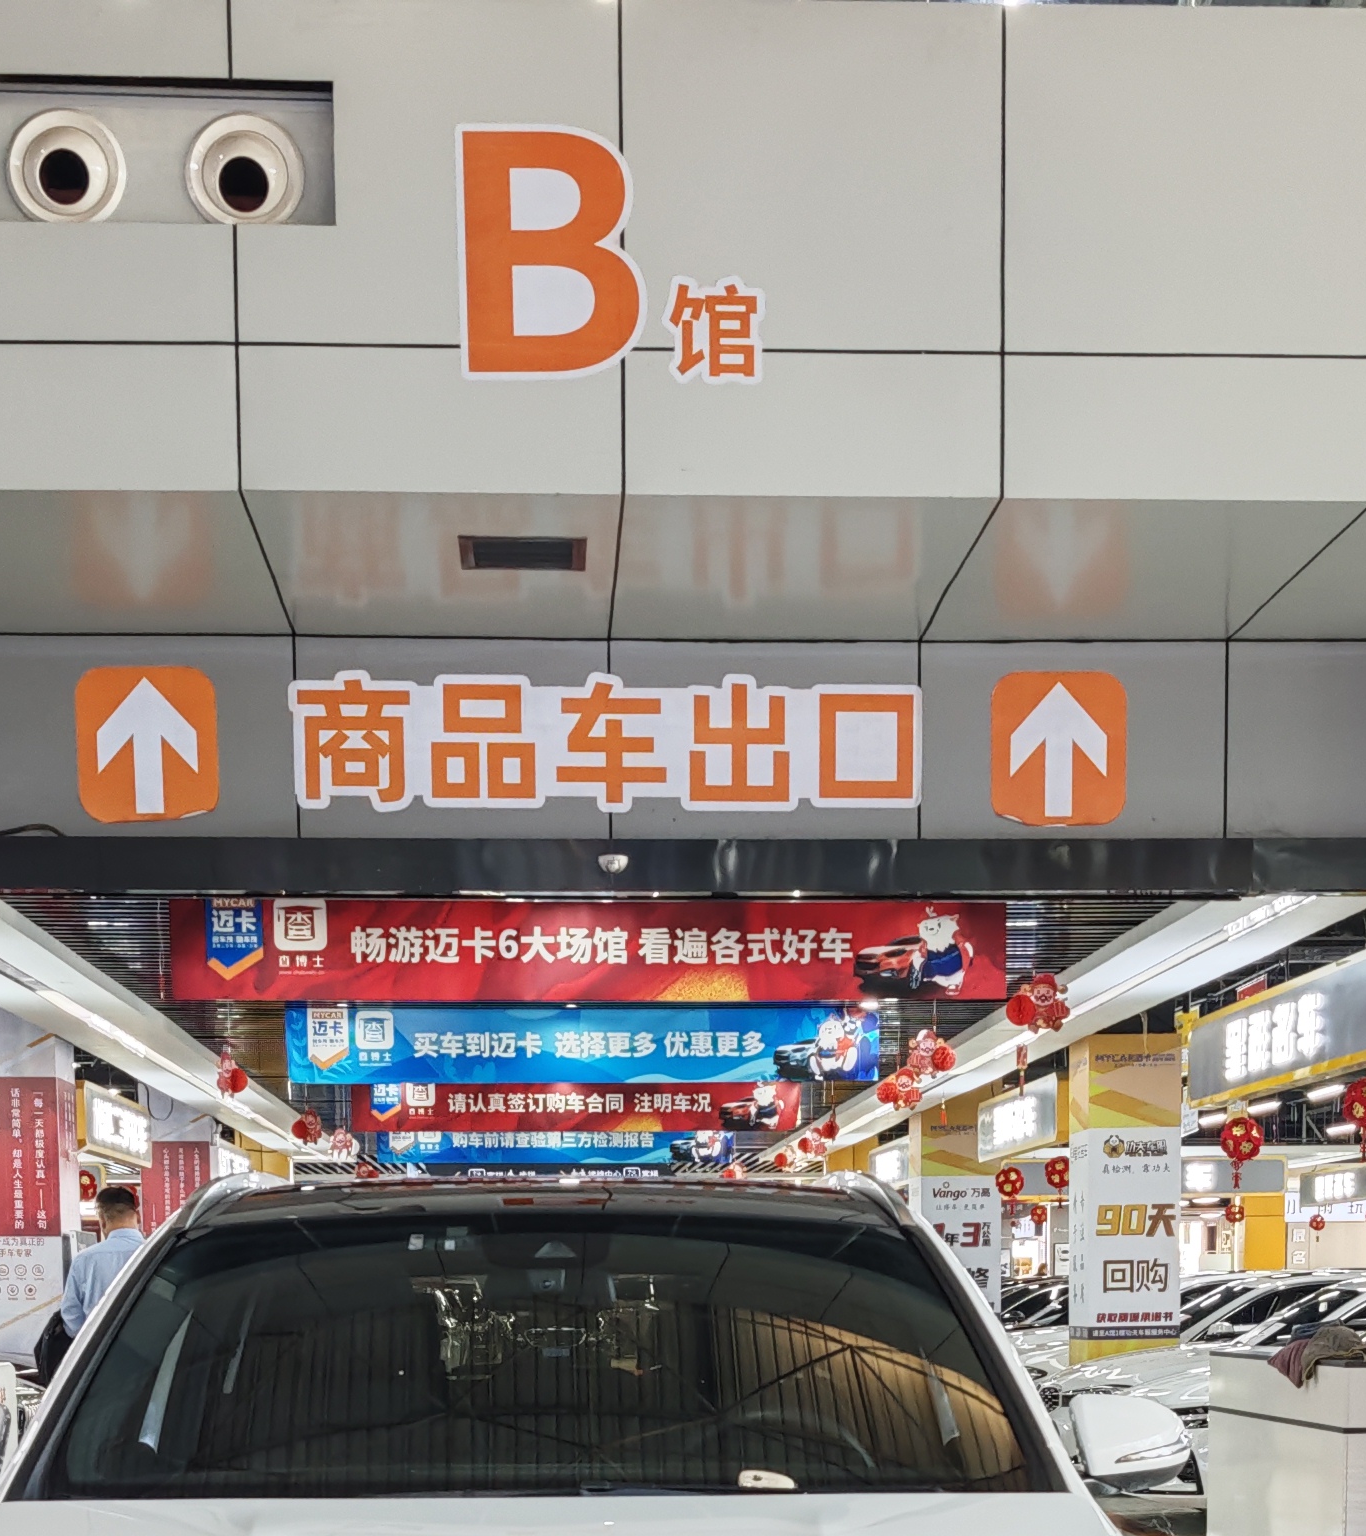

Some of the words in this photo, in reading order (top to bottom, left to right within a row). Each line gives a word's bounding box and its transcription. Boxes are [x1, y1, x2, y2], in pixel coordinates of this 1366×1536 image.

[297, 676, 915, 804] 商品车出口
[211, 909, 258, 933] 迈卡
[350, 926, 629, 965] 畅游迈卡6大场馆
[638, 926, 854, 965] 看遍各式好车
[278, 955, 325, 969] 查博士
[312, 1020, 345, 1037] 迈卡
[414, 1032, 543, 1059] 买车到迈卡
[555, 1032, 657, 1059] 选择更多
[664, 1031, 766, 1058] 优惠更多
[447, 1092, 624, 1115] 请认真签订购车合同
[634, 1093, 712, 1115] 注明车况
[453, 1131, 655, 1149] 购车前请查验第三方检测报告
[932, 1187, 968, 1200] Vango
[1096, 1203, 1177, 1237] 90天
[1103, 1258, 1170, 1293] 回购
